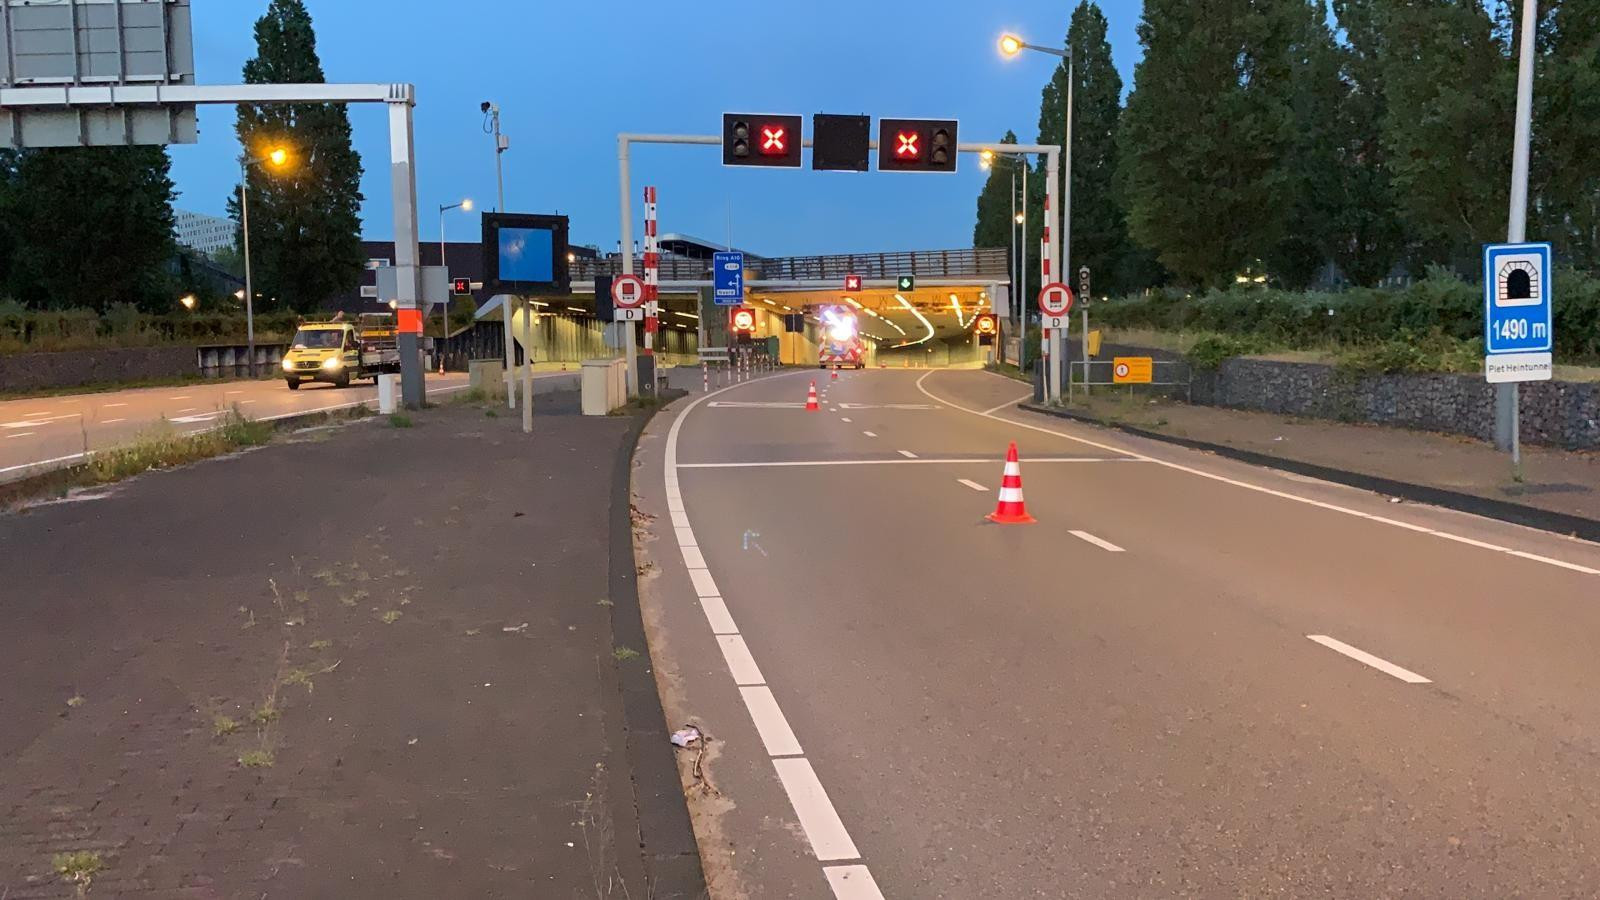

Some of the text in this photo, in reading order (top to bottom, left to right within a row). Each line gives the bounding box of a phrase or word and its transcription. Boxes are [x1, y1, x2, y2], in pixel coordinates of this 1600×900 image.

[626, 310, 634, 320] D
[1052, 317, 1061, 328] D
[1493, 319, 1546, 340] 1490 m
[1488, 365, 1505, 373] Piet
